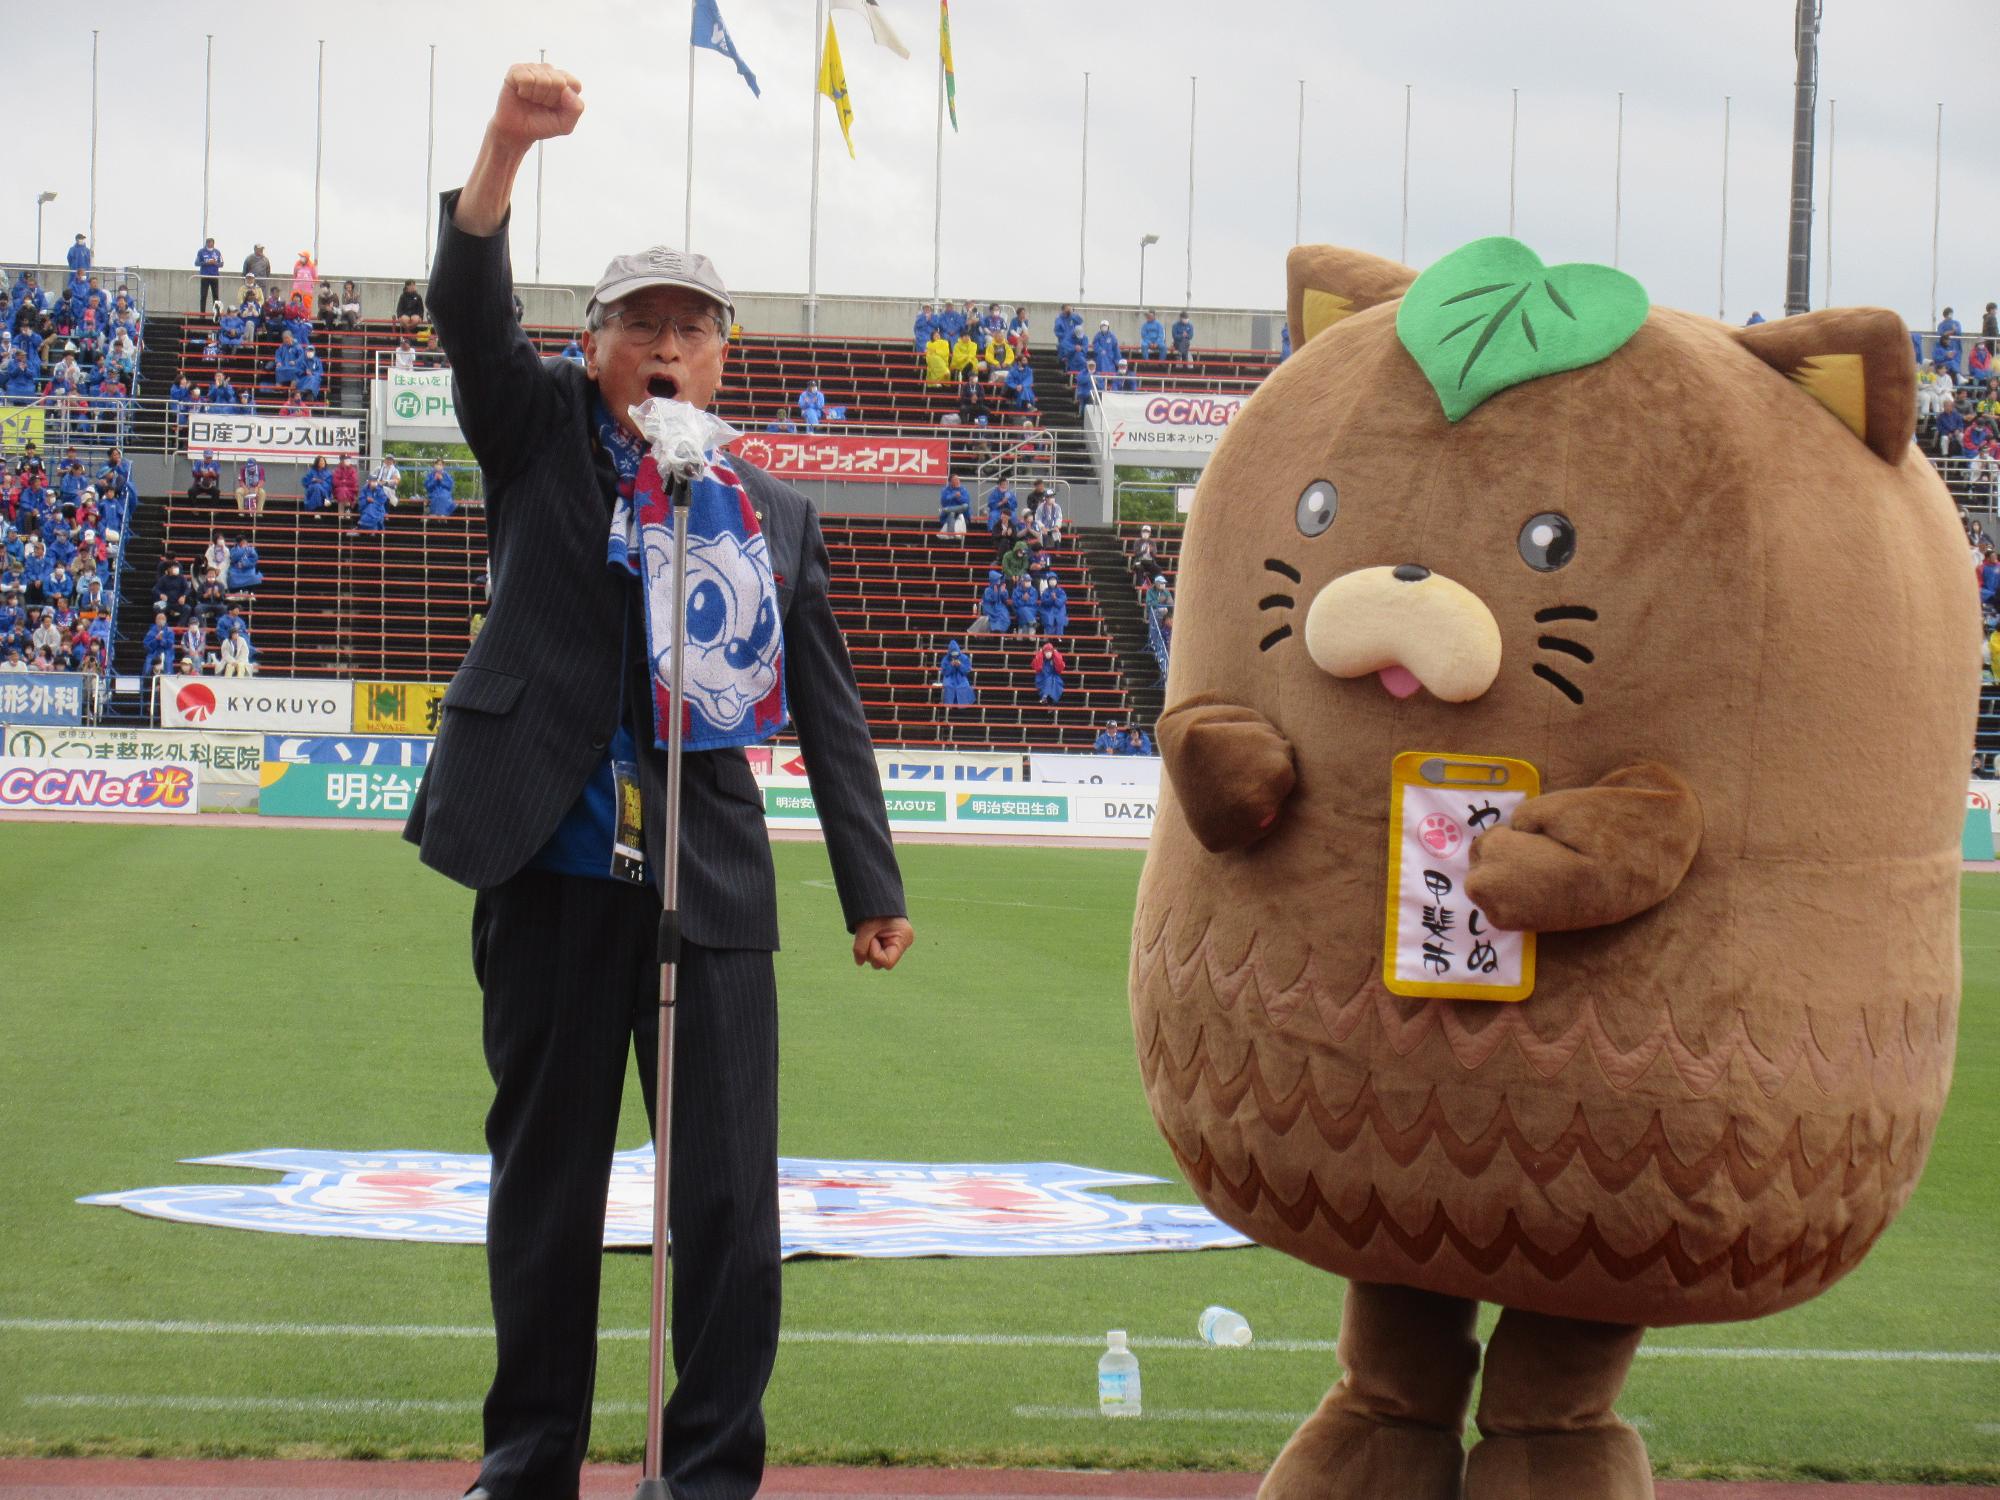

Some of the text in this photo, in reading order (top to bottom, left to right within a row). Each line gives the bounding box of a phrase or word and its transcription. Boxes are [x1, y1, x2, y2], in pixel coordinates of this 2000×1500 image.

[1146, 399, 1238, 426] CCNet
[190, 421, 358, 448] 日産プリンス山梨
[775, 444, 939, 473] アドヴォネクスト
[0, 685, 79, 717] 形外科
[228, 696, 336, 714] KYOKUYO
[368, 723, 406, 732] HAYATE
[327, 774, 421, 810] 明治
[972, 800, 1060, 816] 明治安田生命
[1422, 869, 1456, 976] 甲斐市
